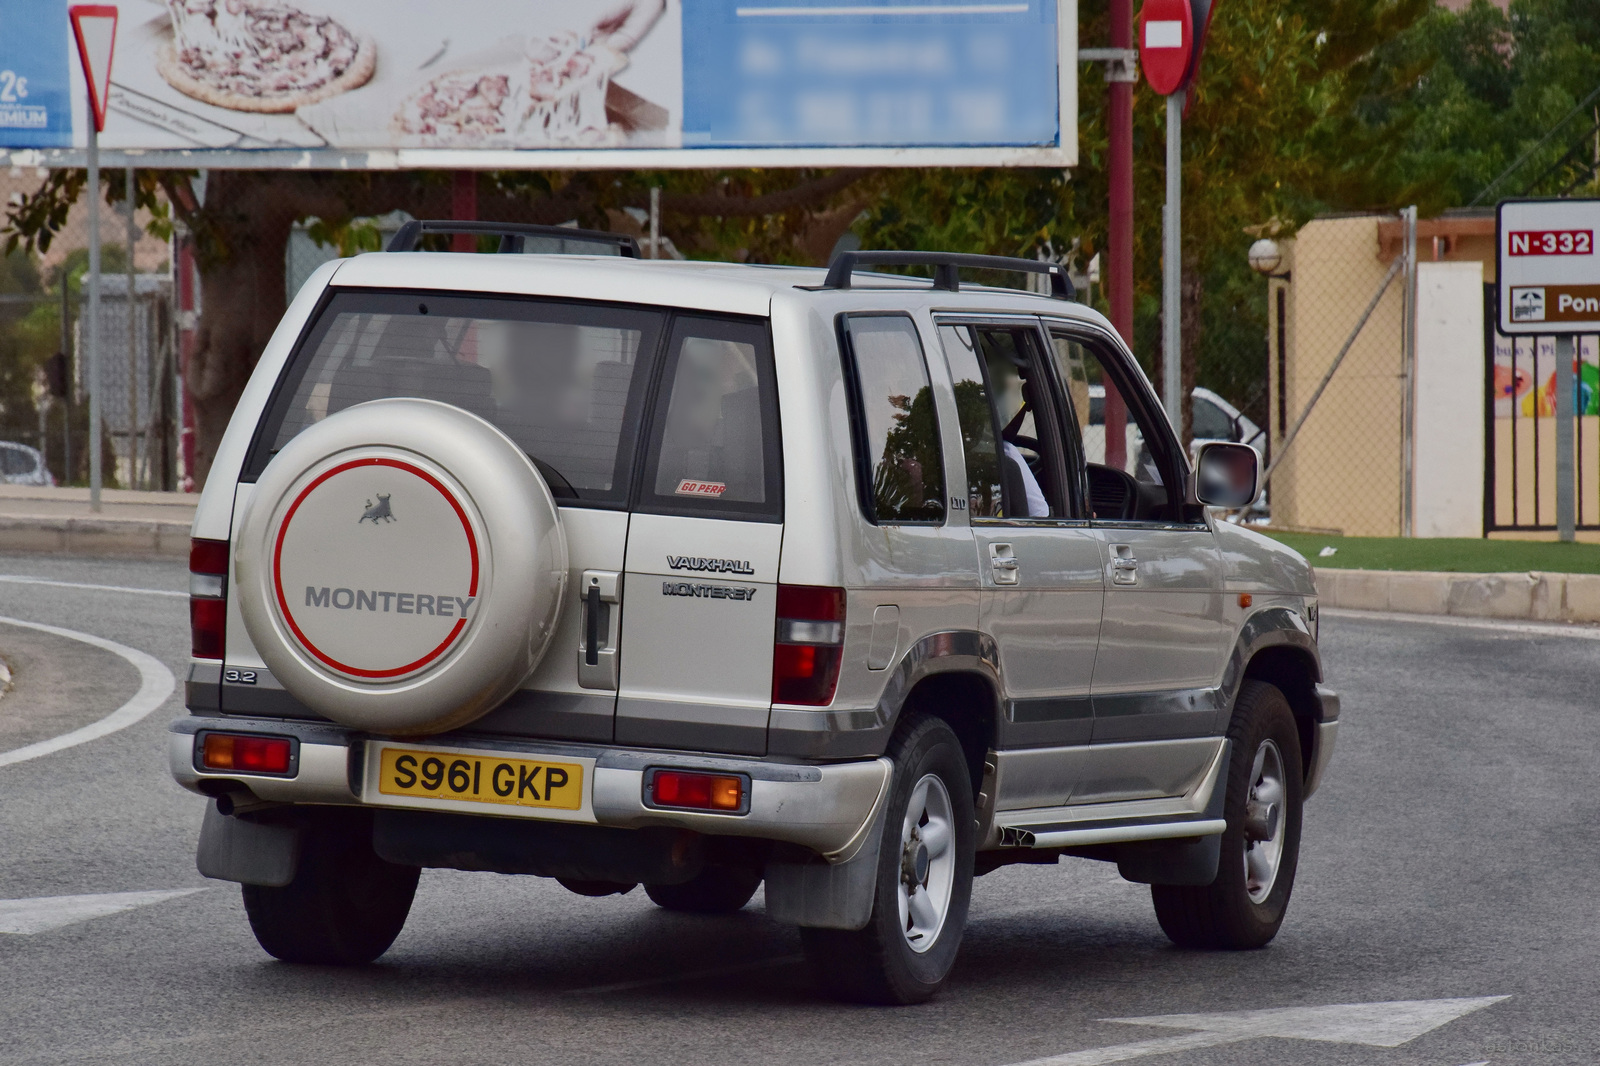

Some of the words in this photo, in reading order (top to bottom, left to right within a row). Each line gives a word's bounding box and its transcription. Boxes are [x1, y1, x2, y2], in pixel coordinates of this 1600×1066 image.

[1512, 232, 1590, 253] N-332
[1558, 294, 1600, 313] Pon
[681, 482, 697, 492] GO
[666, 555, 754, 575] VAUXHALL
[662, 582, 757, 601] MONTEREY
[305, 586, 475, 618] MONTEREY
[226, 670, 257, 684] 3.2
[394, 755, 481, 795] S961
[492, 763, 569, 801] GKP
